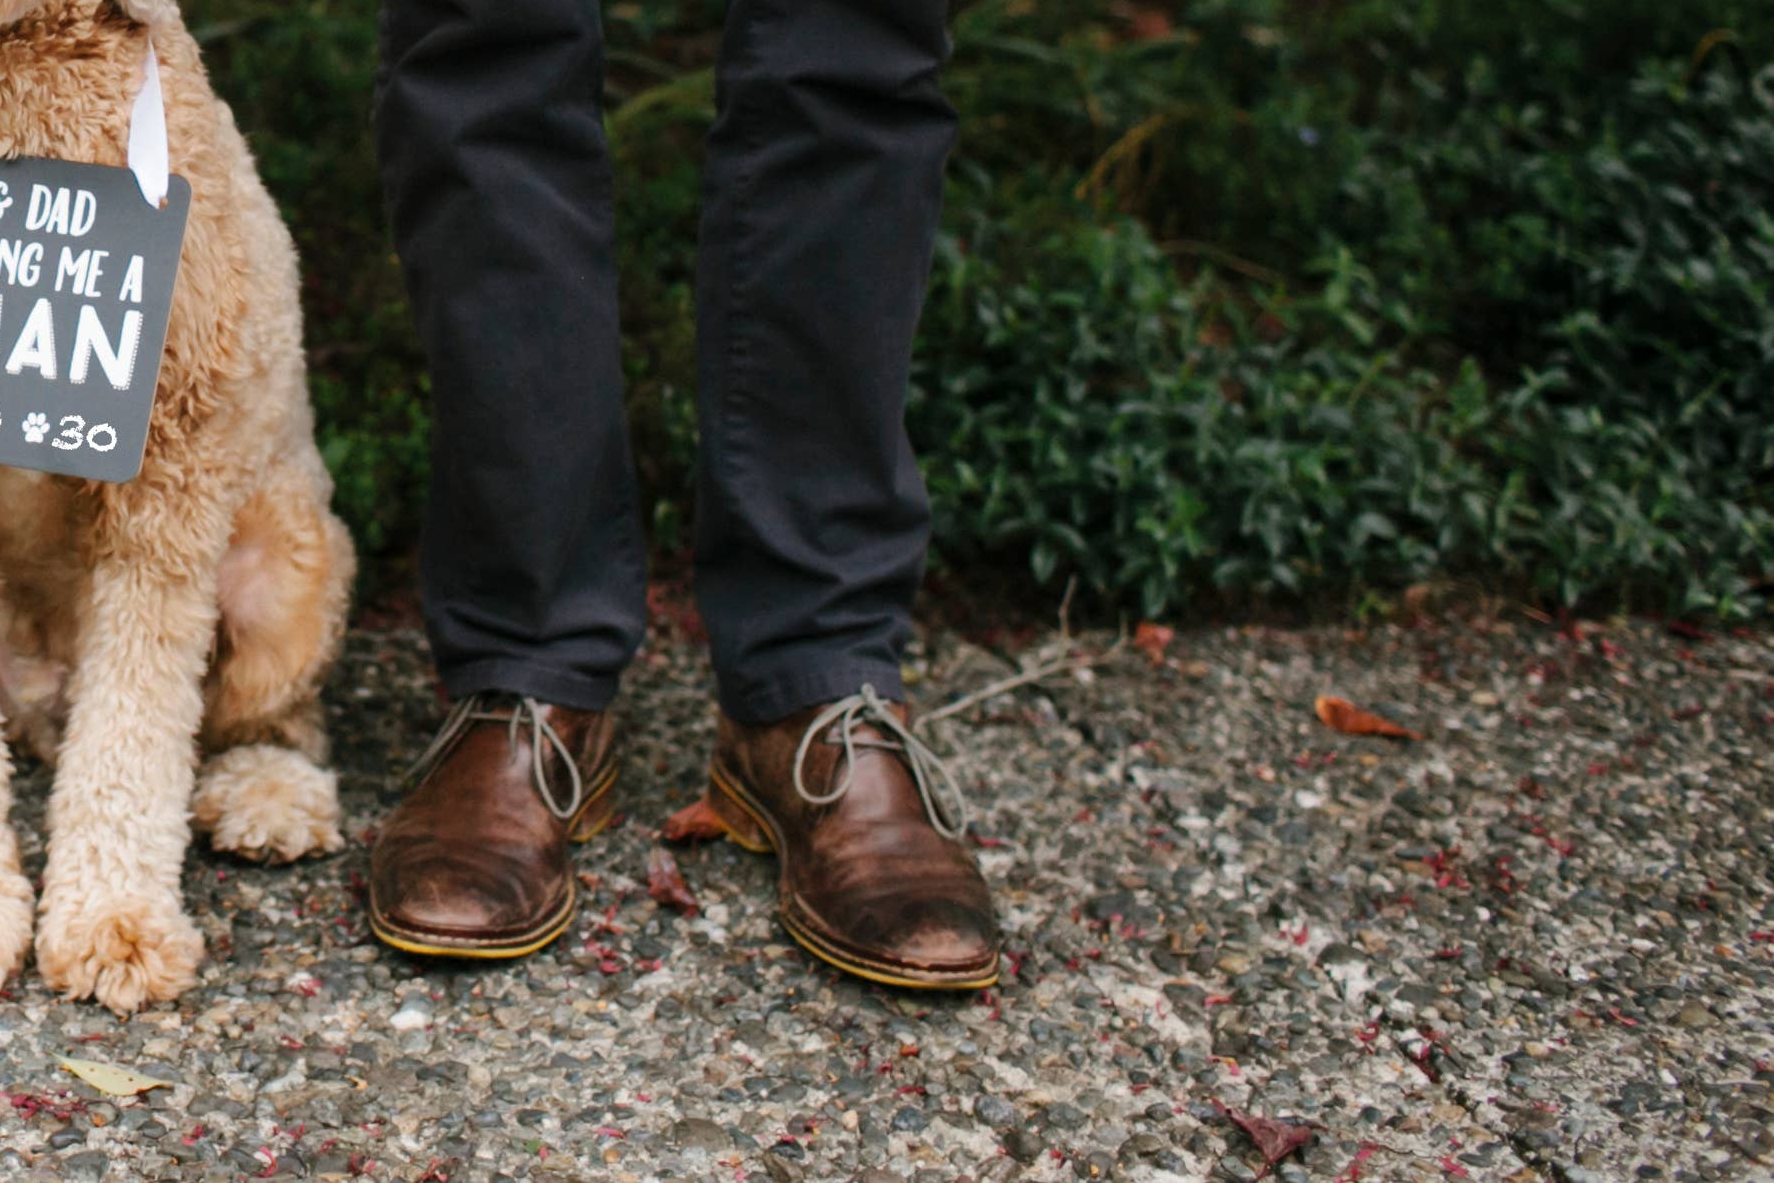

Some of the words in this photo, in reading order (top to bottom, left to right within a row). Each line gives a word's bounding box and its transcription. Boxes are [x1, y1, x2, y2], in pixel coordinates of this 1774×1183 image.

[25, 183, 97, 237] DAD
[54, 246, 109, 298] ME
[119, 255, 144, 303] A
[51, 415, 117, 452] 30
